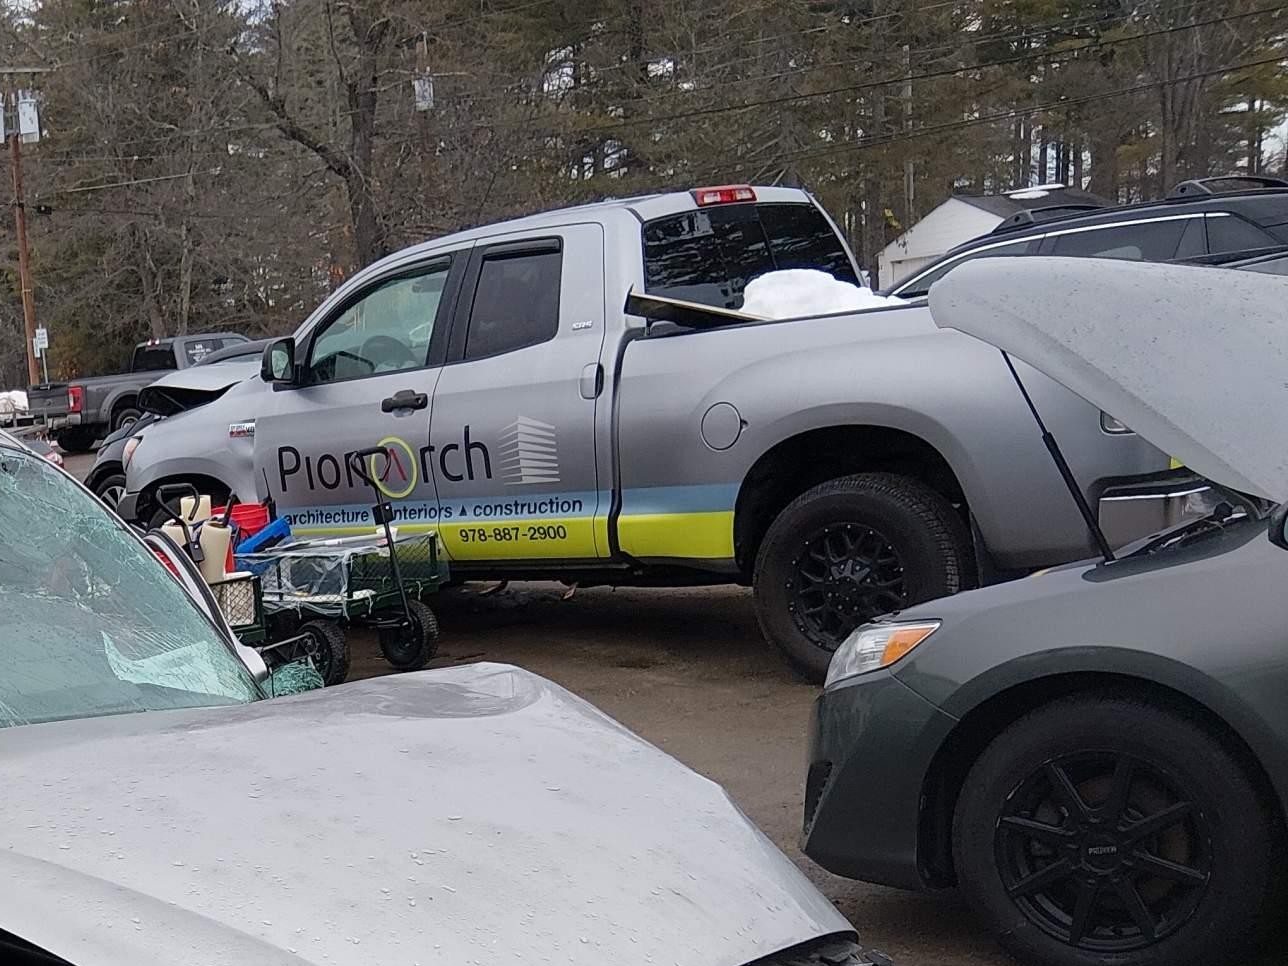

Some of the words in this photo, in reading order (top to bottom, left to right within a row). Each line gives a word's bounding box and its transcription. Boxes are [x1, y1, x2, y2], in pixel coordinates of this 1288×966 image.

[285, 508, 369, 526] architecture
[391, 503, 453, 521] nteriors
[473, 497, 583, 517] construction
[459, 525, 567, 542] 978-887-2900
